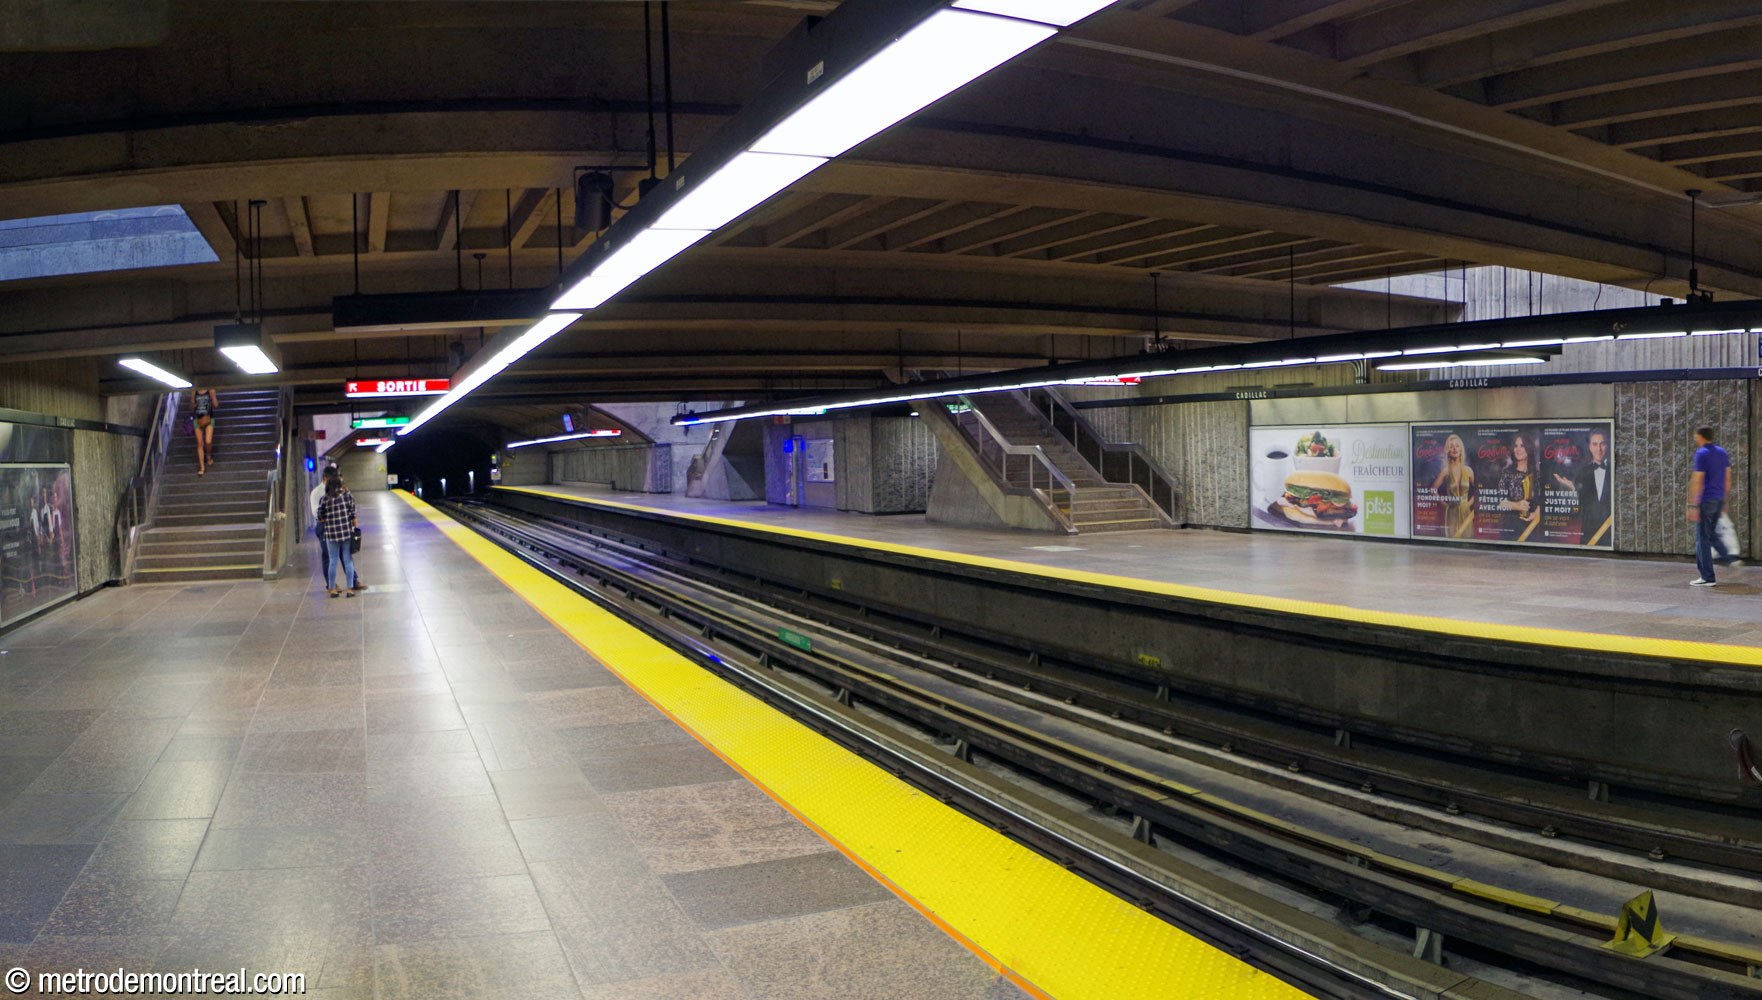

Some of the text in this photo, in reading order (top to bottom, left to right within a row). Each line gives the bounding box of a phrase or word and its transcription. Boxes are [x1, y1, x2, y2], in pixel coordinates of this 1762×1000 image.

[376, 380, 427, 392] SORTIE
[1450, 379, 1488, 388] CADILLAC
[1236, 391, 1267, 399] CADILLAC
[1352, 439, 1405, 464] Destination
[1353, 464, 1404, 477] FRAÎCHEUR
[1478, 488, 1509, 496] VIENS-TU
[1556, 490, 1578, 498] VERRE
